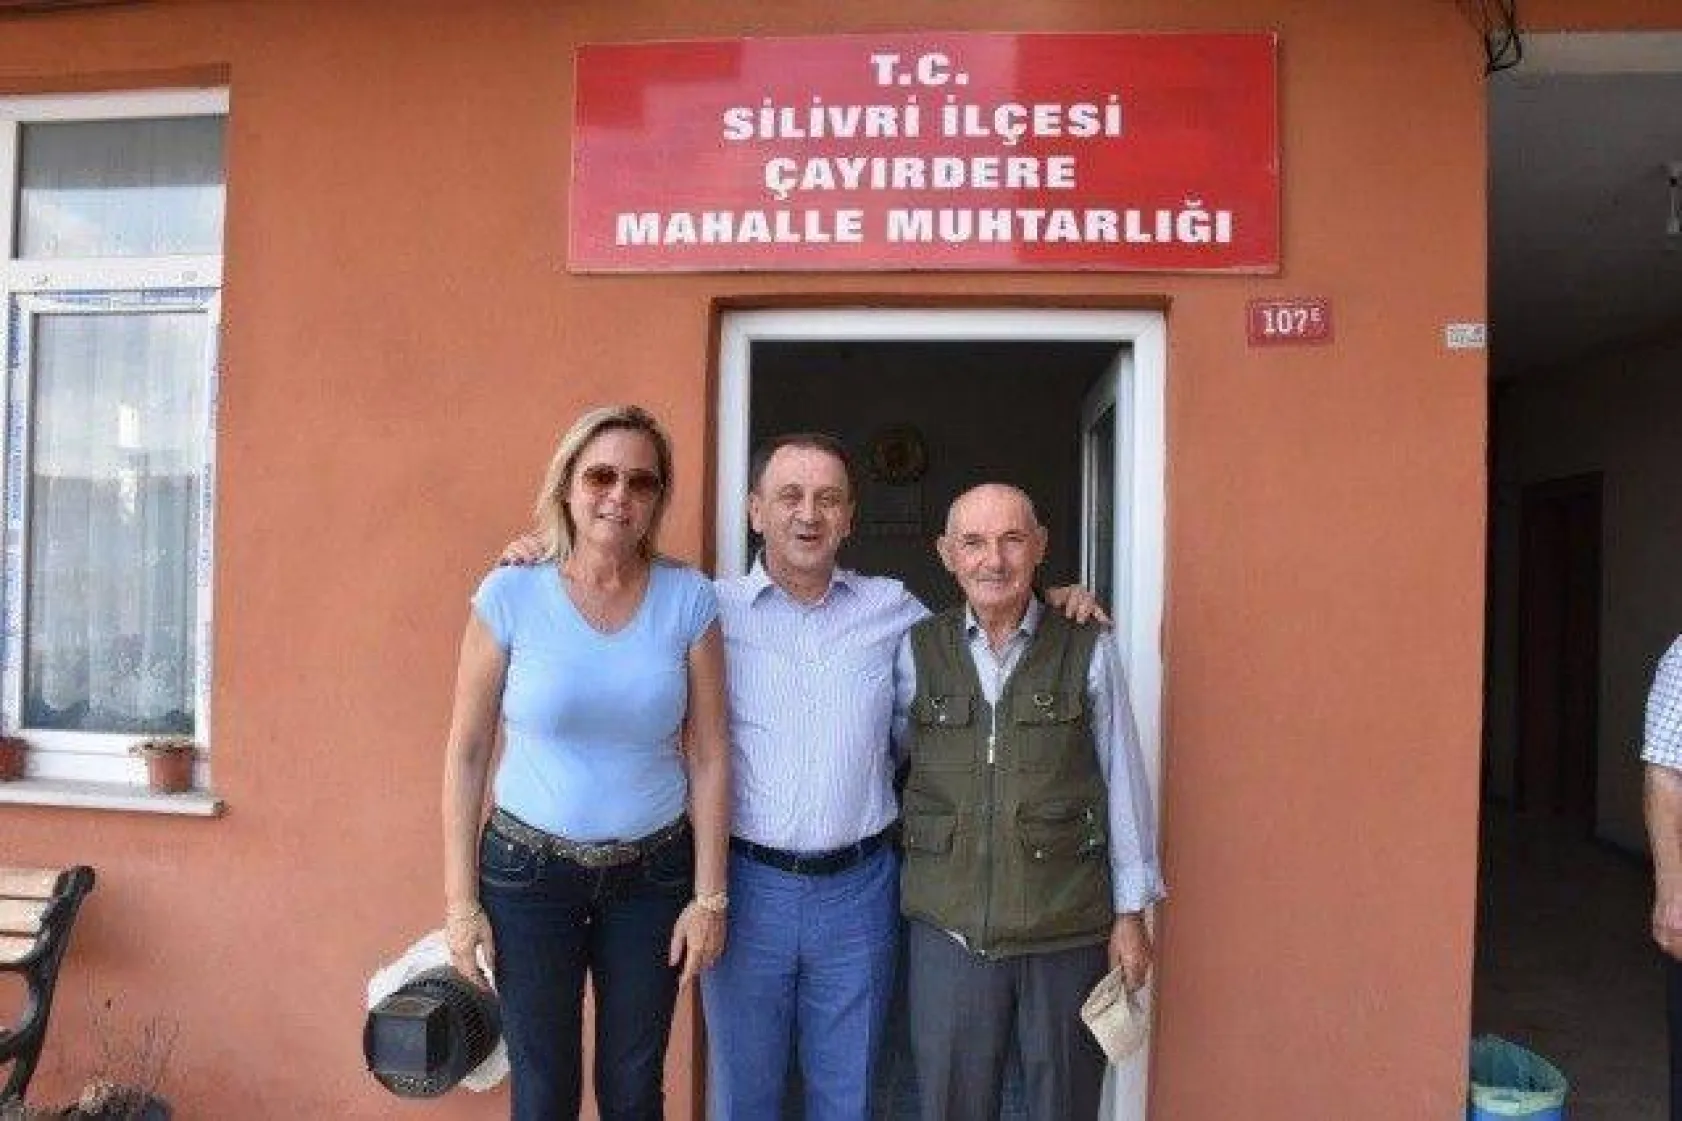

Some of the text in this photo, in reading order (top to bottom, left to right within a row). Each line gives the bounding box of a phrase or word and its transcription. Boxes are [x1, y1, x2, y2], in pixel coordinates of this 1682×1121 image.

[871, 53, 969, 85] T.C.
[723, 94, 1122, 145] SİLİVRİ İLÇESİ
[764, 156, 1076, 199] ÇAYIRDERE
[616, 199, 1232, 246] MAHALLE MUHTARLIĞI
